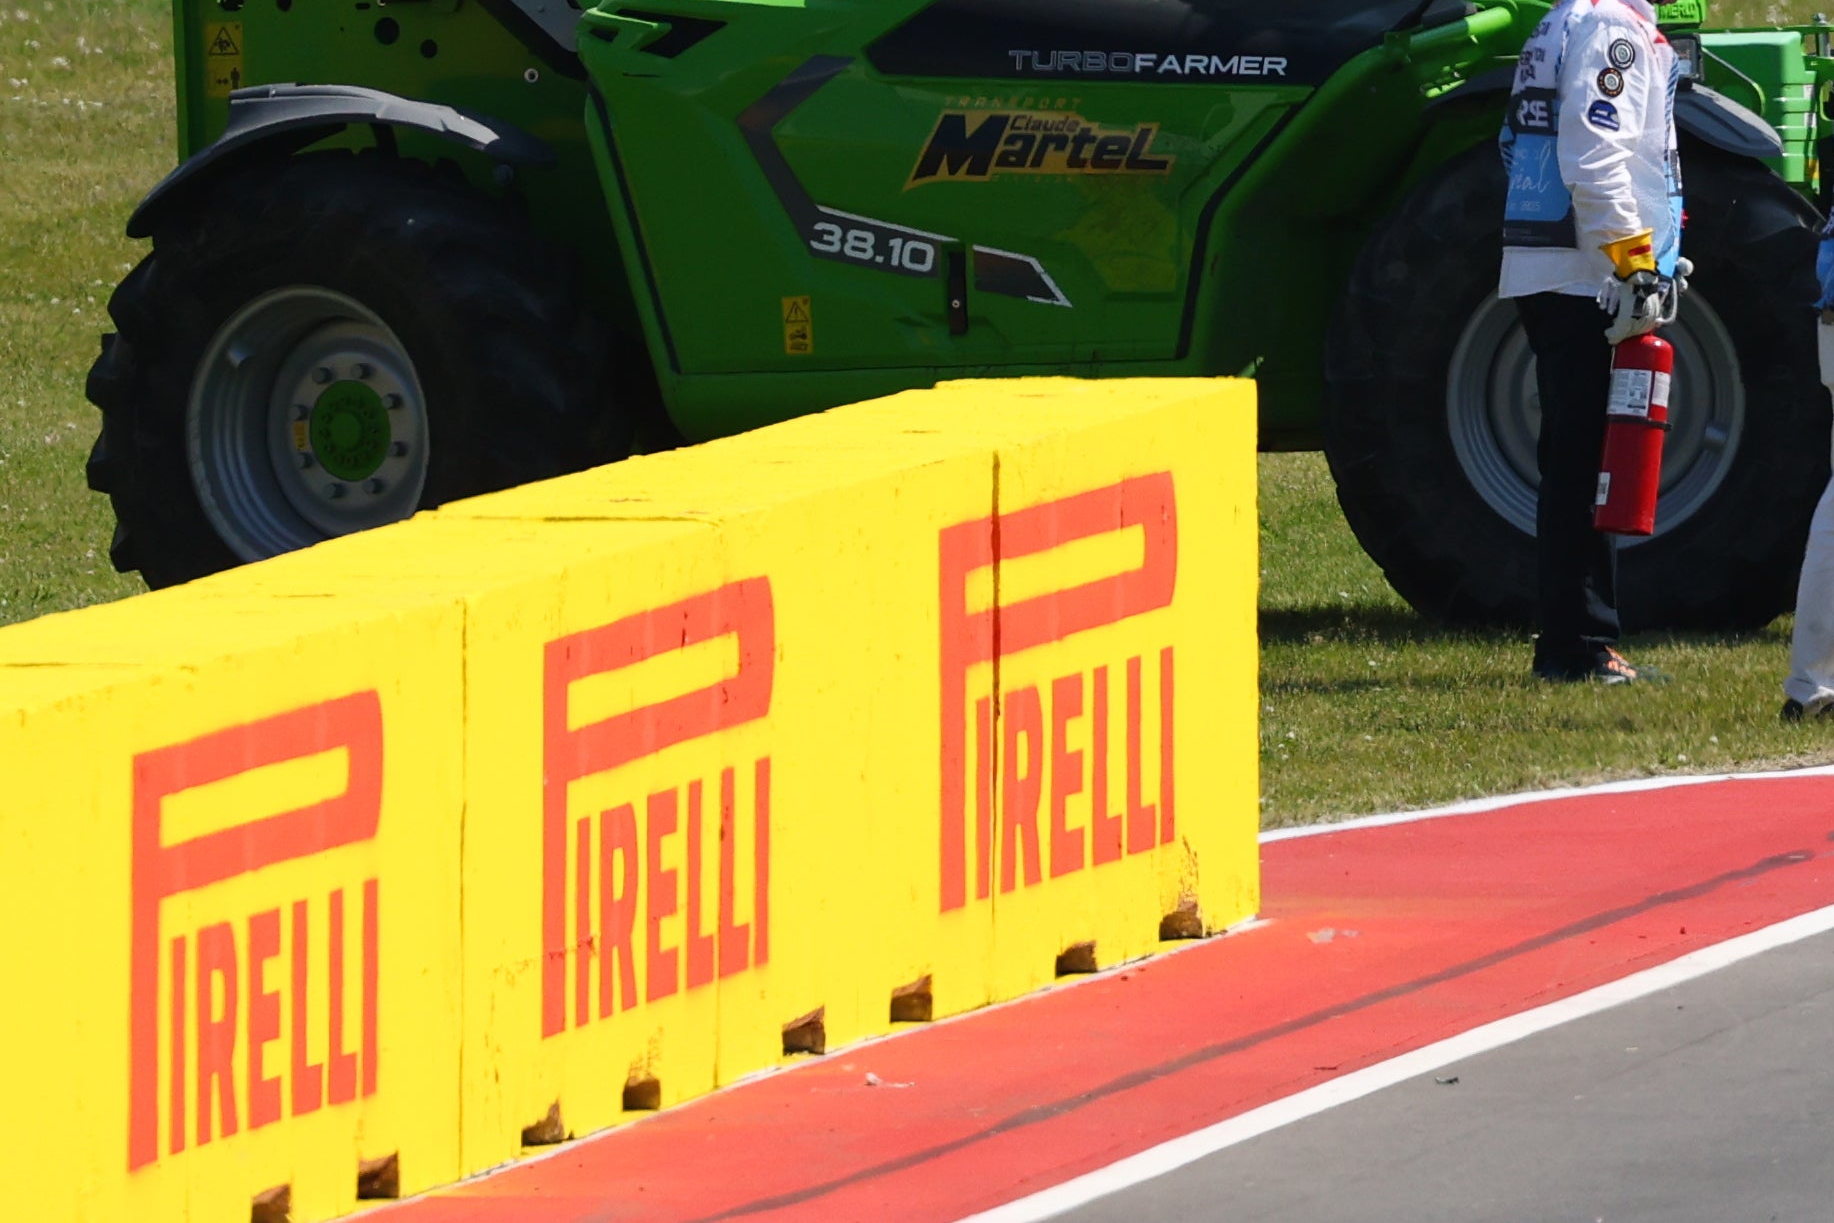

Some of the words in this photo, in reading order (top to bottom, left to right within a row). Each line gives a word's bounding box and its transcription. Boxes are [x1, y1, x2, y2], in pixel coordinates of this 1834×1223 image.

[1008, 49, 1288, 76] TURBOFARMER
[1009, 113, 1080, 133] Claude
[810, 221, 935, 273] 38.10
[539, 573, 776, 1039] PIRELLI
[935, 468, 1179, 914] PIRELLI
[126, 687, 385, 1174] PIRELLI
